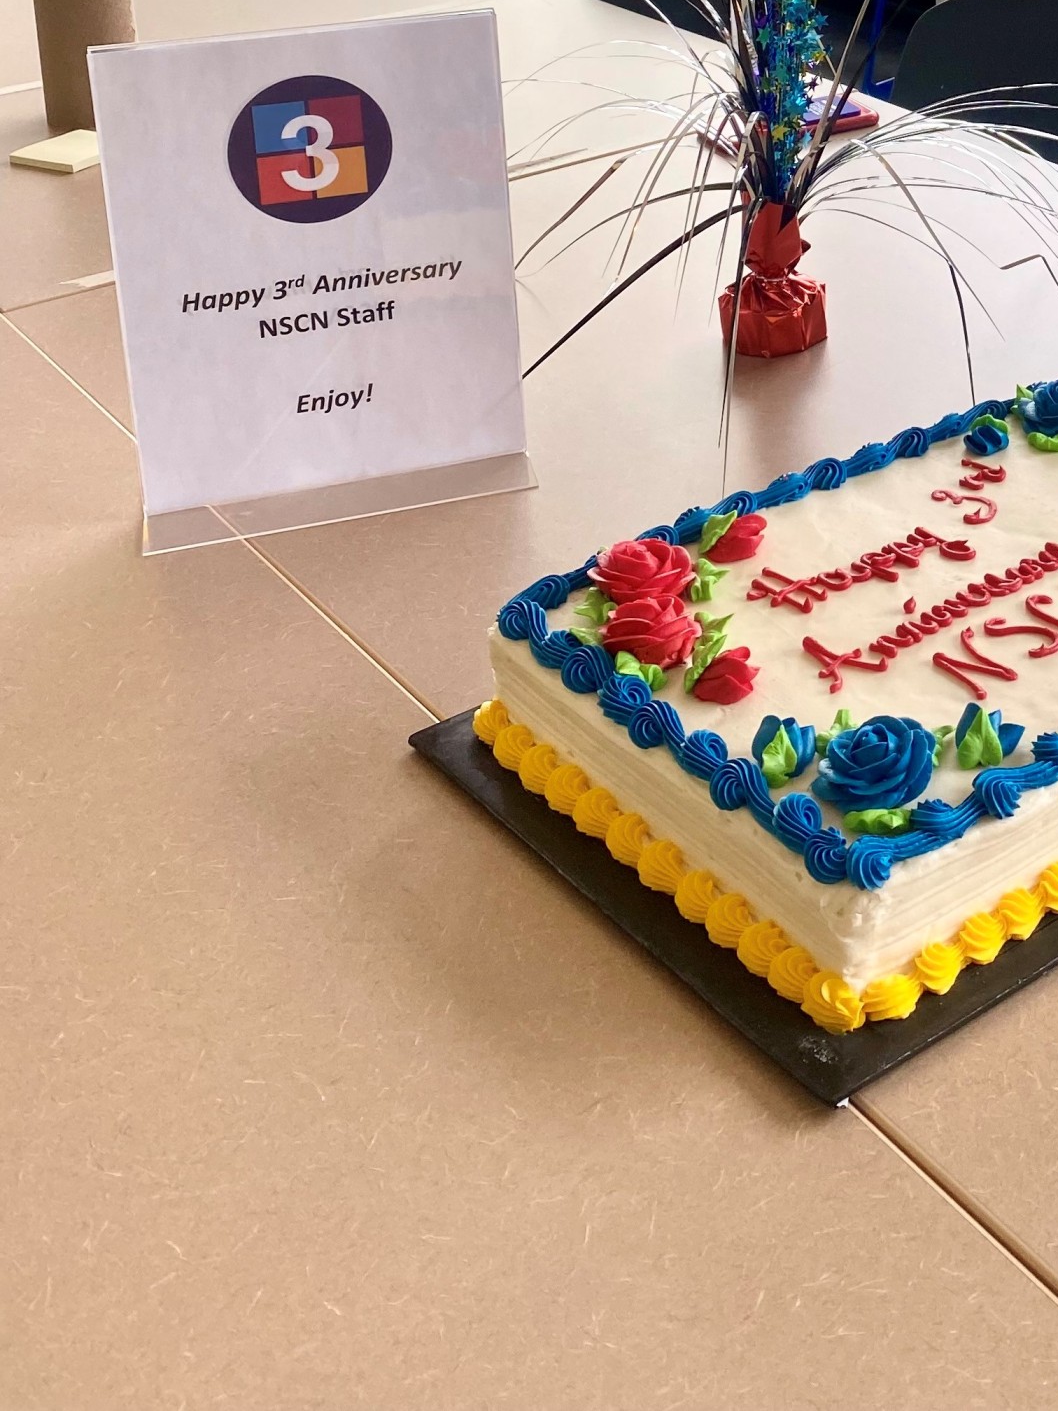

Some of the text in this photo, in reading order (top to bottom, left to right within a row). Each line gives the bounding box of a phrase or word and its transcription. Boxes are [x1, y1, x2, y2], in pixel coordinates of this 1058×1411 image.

[280, 114, 339, 192] 3
[182, 260, 463, 313] Happy 3rd Anniversary
[259, 300, 395, 339] NSCN Staff
[296, 383, 373, 414] Enjoy!
[746, 525, 977, 615] Happy
